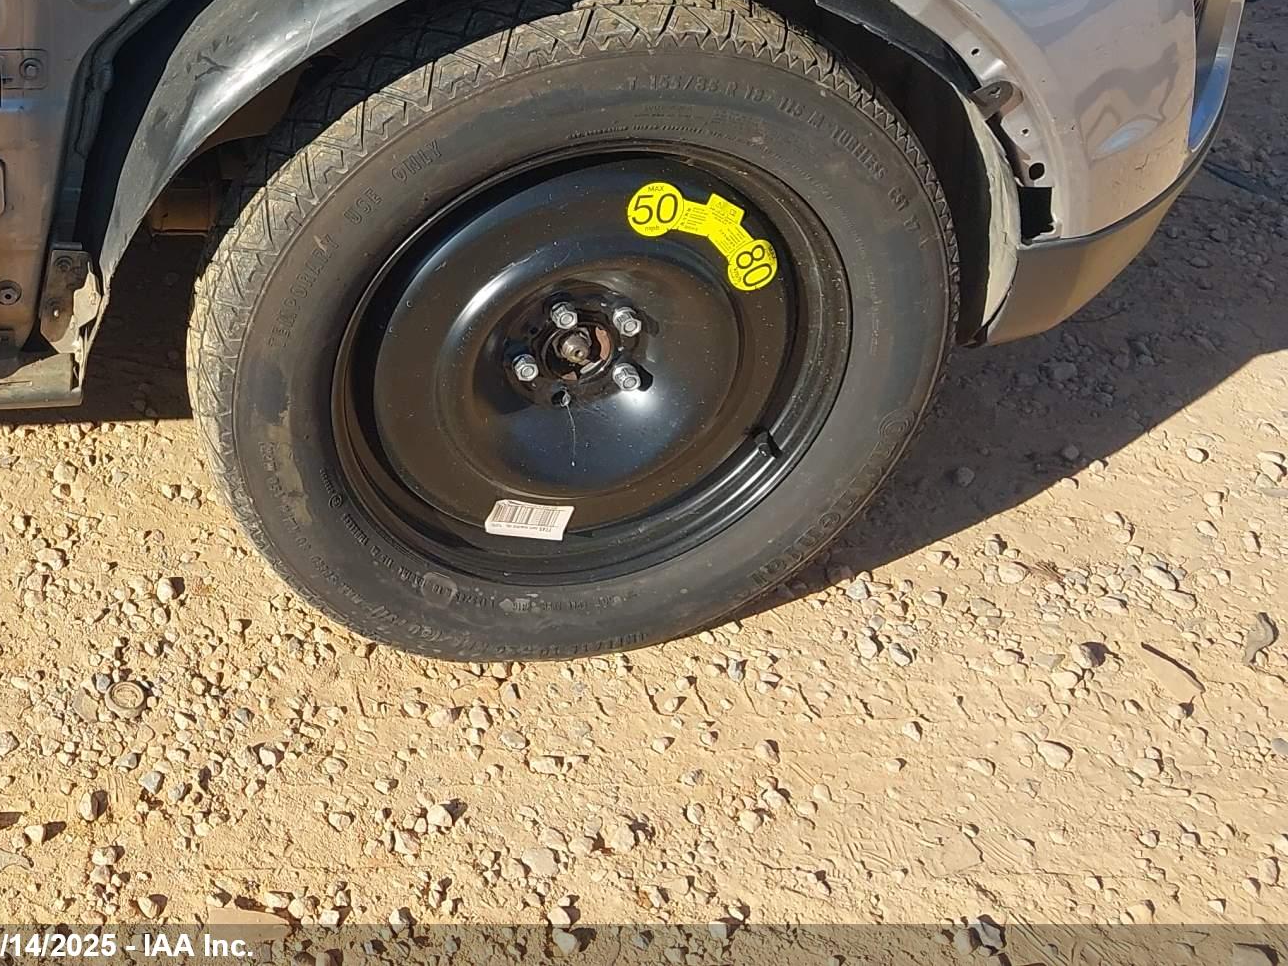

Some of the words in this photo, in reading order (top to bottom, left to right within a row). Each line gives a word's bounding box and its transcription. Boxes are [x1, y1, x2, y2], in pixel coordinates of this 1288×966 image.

[647, 185, 665, 193] MAX
[631, 192, 679, 226] 50
[268, 233, 341, 348] TEMPORARY
[343, 187, 383, 225] USE
[391, 139, 443, 183] ONLY
[735, 244, 773, 288] 80
